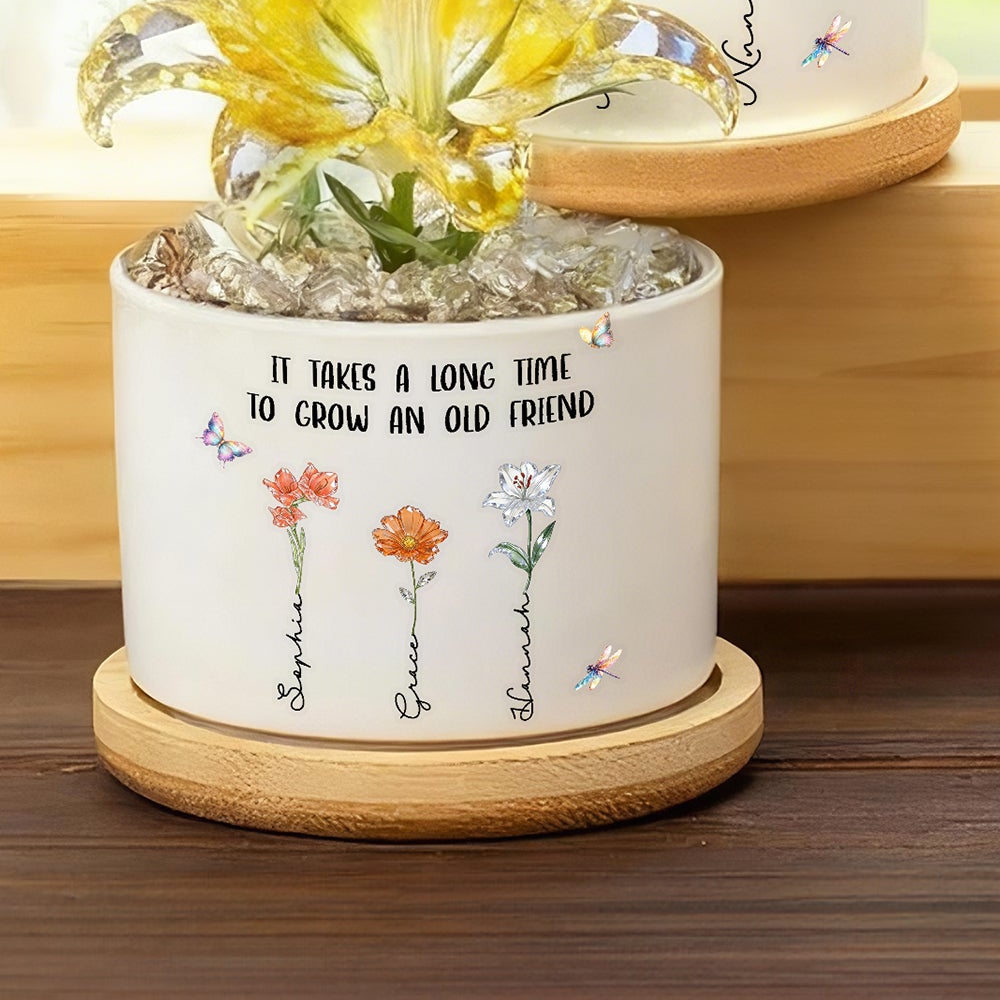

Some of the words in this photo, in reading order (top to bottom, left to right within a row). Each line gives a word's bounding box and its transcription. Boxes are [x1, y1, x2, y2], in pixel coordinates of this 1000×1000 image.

[246, 391, 276, 422] TO
[294, 399, 369, 433] GROW
[389, 405, 425, 435] AN
[444, 403, 490, 433] OLD
[509, 389, 595, 428] FRIEND
[271, 355, 291, 385] IT
[308, 359, 376, 392] TAKES
[395, 363, 410, 393] A
[430, 361, 496, 392] LONG
[513, 353, 572, 387] TIME
[278, 593, 312, 712] Sophia
[395, 633, 432, 720] Grace
[507, 592, 534, 722] Hannah
